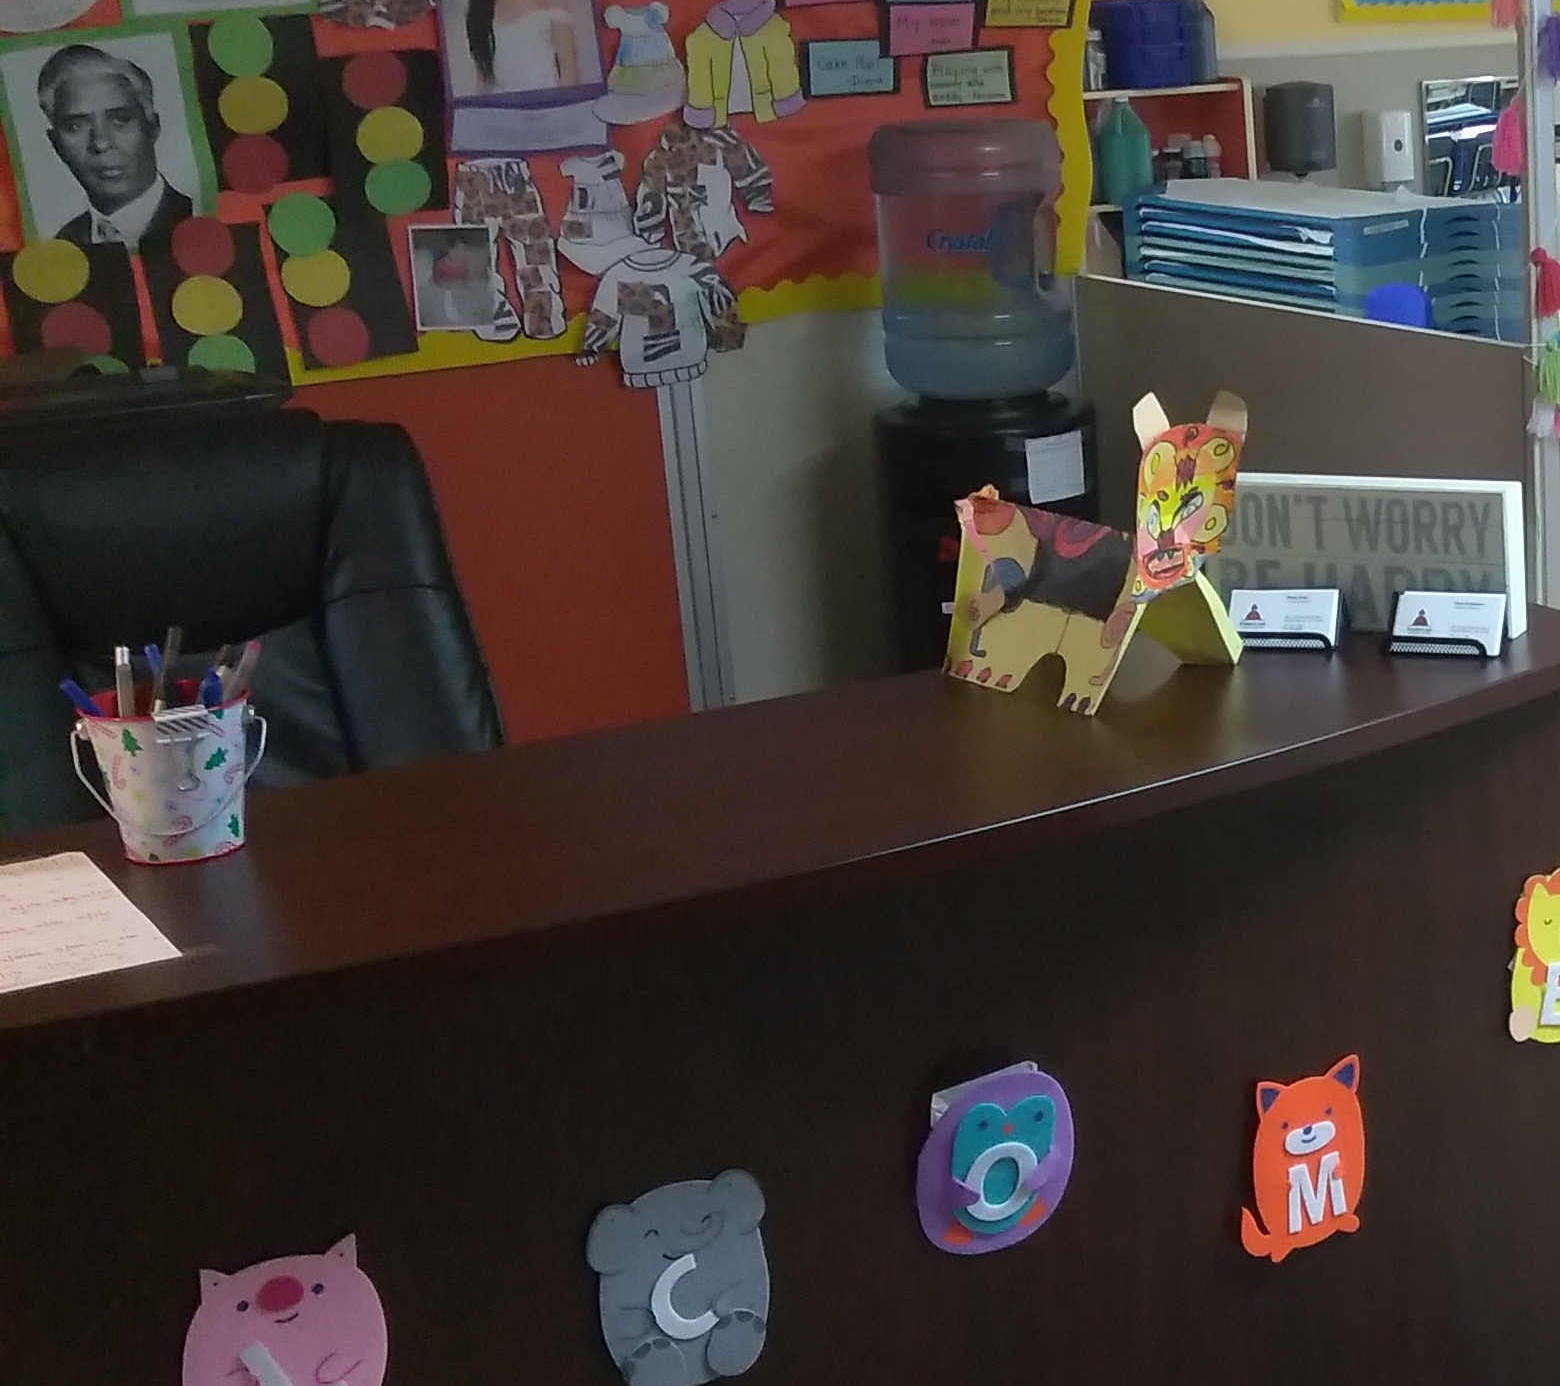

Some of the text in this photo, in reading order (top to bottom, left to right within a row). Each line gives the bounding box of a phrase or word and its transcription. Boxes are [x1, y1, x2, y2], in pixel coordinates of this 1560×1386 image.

[1343, 497, 1492, 558] WORRY
[650, 1252, 721, 1341] C
[962, 1140, 1039, 1222] O
[1286, 1150, 1348, 1235] M
